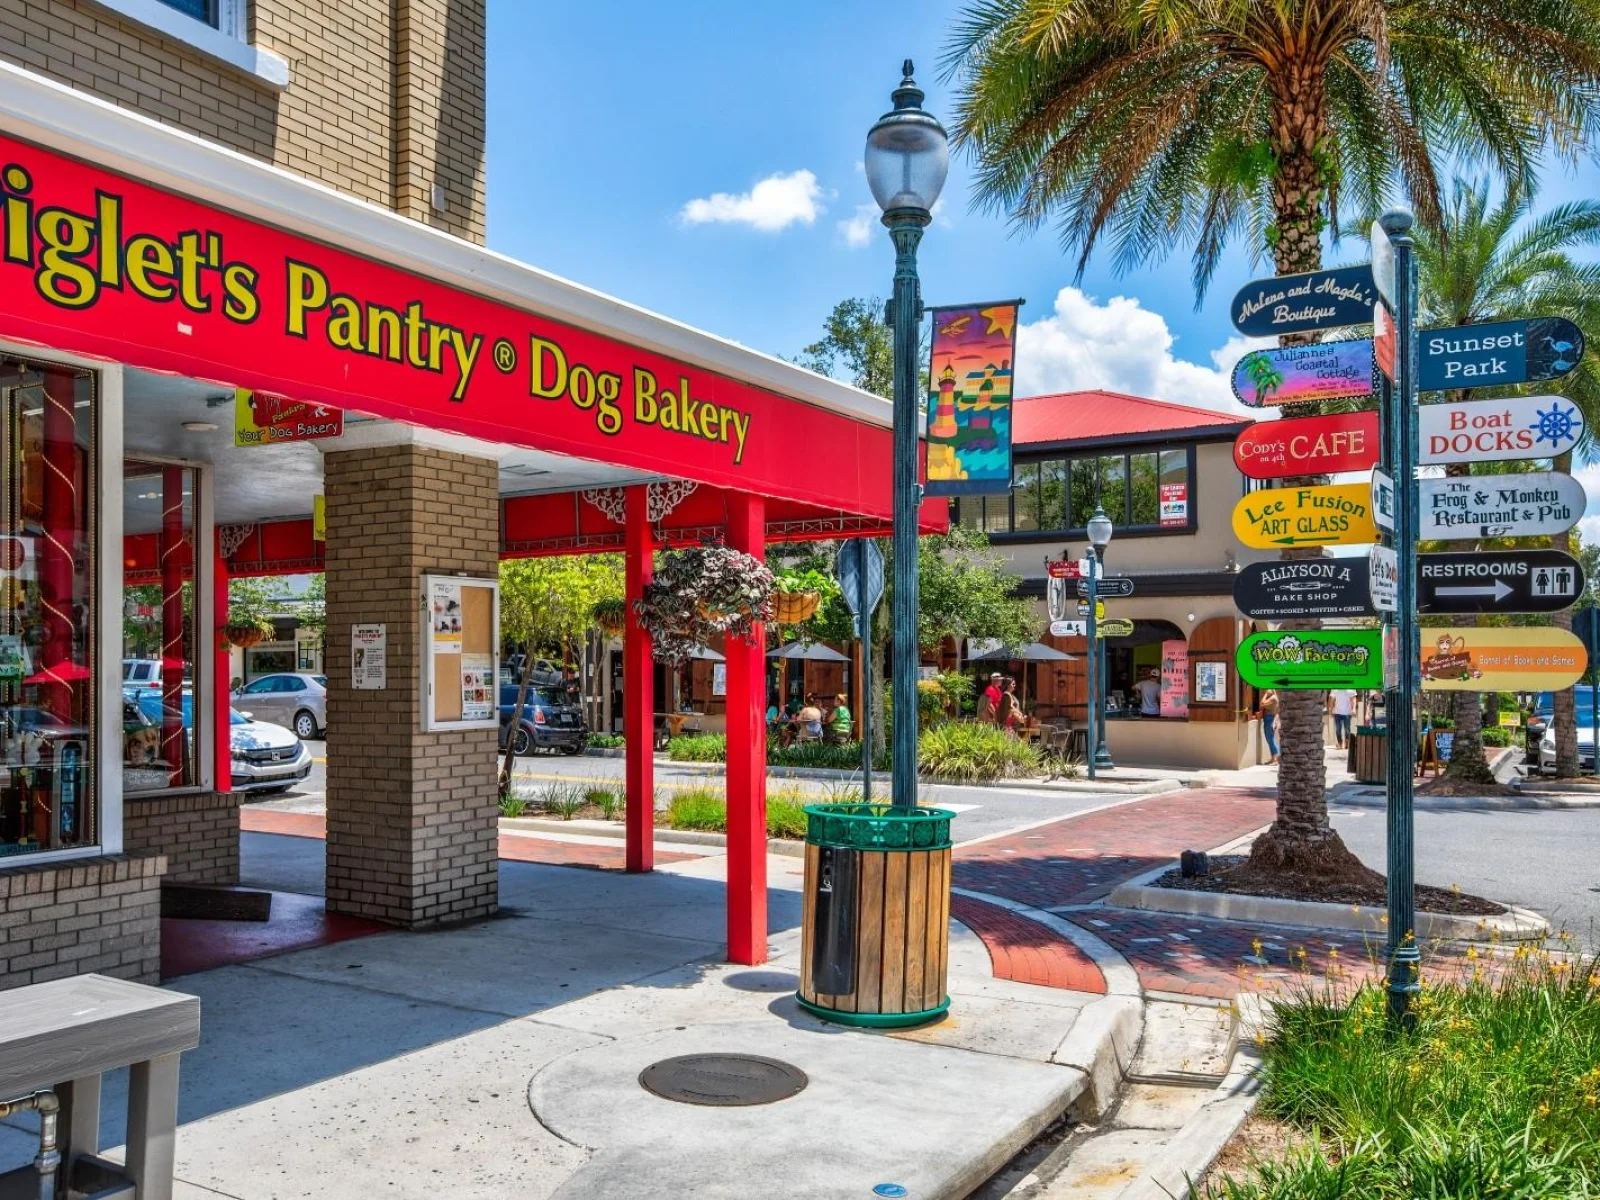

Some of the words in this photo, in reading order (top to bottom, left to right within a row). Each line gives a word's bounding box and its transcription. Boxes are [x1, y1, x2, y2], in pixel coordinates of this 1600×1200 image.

[1287, 277, 1311, 298] and
[1314, 278, 1372, 306] Magda's
[0, 163, 260, 324] iglet's
[285, 256, 485, 402] Pantry
[529, 333, 622, 434] Dog
[632, 364, 751, 465] Bakery
[1272, 304, 1336, 324] Boutique
[1429, 332, 1525, 355] Sunset
[1295, 357, 1339, 371] Coastal
[1317, 365, 1360, 379] Cottage
[1445, 358, 1507, 378] Park
[297, 422, 338, 436] Bakery
[1450, 409, 1512, 430] Boat
[1290, 430, 1365, 459] CAFE
[1429, 429, 1533, 455] DOCKS
[1260, 455, 1269, 463] on
[1271, 453, 1285, 464] 4th
[1447, 483, 1471, 492] The
[1244, 500, 1285, 524] Lee
[1297, 490, 1366, 518] Fusion
[1430, 493, 1467, 509] Frog
[1473, 491, 1489, 506] &
[1495, 488, 1560, 507] Monkey
[1260, 518, 1291, 536] ART
[1297, 515, 1349, 533] GLASS
[1432, 507, 1520, 527] Restaurant
[1522, 510, 1534, 521] &
[1537, 504, 1571, 523] Pub
[1260, 564, 1336, 585] ALLYSON
[1337, 568, 1351, 582] A
[1421, 562, 1528, 578] RESTROOMS
[1274, 594, 1303, 602] BAKE
[1307, 592, 1337, 601] SHOP
[1257, 647, 1301, 661] WOW
[1304, 647, 1366, 666] Factory
[1503, 654, 1511, 665] of
